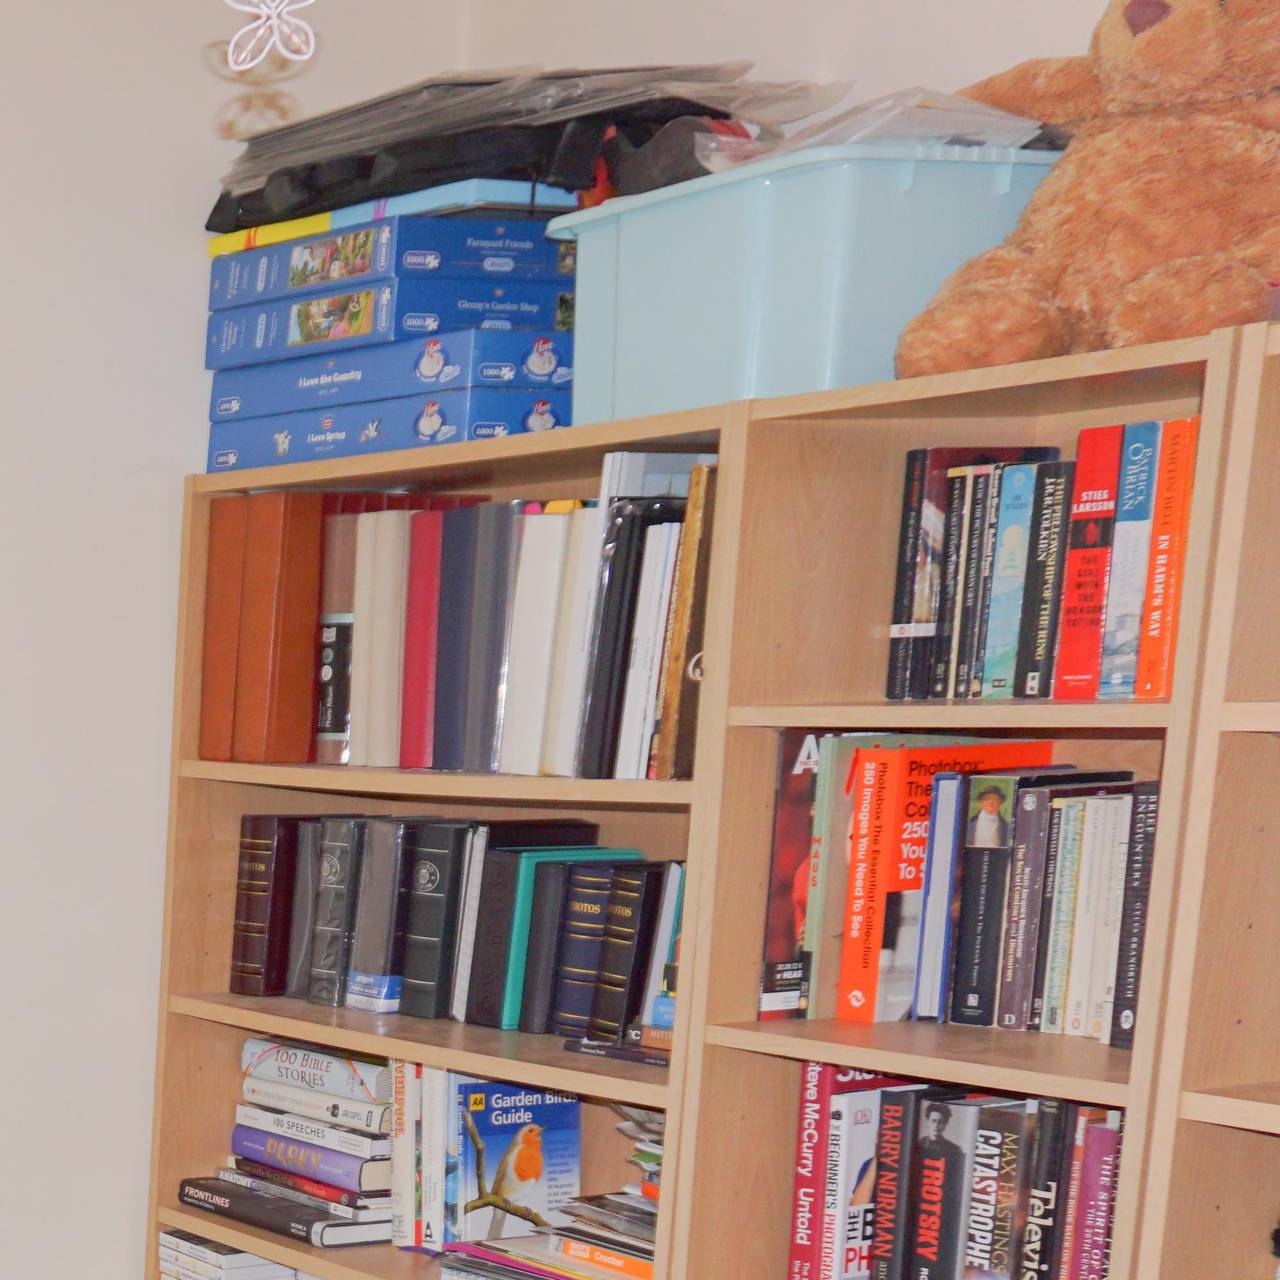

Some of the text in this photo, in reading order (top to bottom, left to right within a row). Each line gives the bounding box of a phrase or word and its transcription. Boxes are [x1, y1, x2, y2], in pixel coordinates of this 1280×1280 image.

[1134, 447, 1153, 505] PATRICK
[1072, 500, 1115, 514] LARSSON
[1080, 489, 1109, 501] STIEG
[1037, 507, 1053, 561] TOLKIEN
[1157, 534, 1170, 550] IN
[1035, 477, 1066, 660] THE FELLOWSHIP OF THE RING
[1151, 554, 1169, 606] HARM'S
[1148, 609, 1162, 639] WAY
[1145, 795, 1157, 834] BRIEF
[850, 762, 876, 939] 250 Images You Need To See
[1131, 795, 1147, 888] ENCOUNTERS
[809, 835, 823, 888] MAUS
[862, 761, 888, 969] Photobox The Essential Collection
[898, 863, 916, 879] To
[1006, 843, 1027, 982] The Social Contract and Discourses
[1124, 936, 1139, 998] BRANDRETH
[274, 1050, 333, 1073] 100 BIBLE
[277, 1066, 325, 1088] STORIES
[492, 1091, 541, 1108] Garden
[272, 1117, 326, 1138] 100 SPEECHES
[492, 1110, 532, 1125] Guide
[880, 1103, 903, 1166] BARRY
[795, 1102, 820, 1245] McCurry Untold
[826, 1133, 841, 1210] BEGINNER'S
[1070, 1160, 1081, 1179] PUT
[1100, 1154, 1114, 1186] THE
[184, 1186, 230, 1208] FRONTLINES
[965, 1129, 1002, 1271] CATASTROPHE
[991, 1131, 1020, 1274] MAX HASTINGS
[1068, 1180, 1079, 1198] THE
[874, 1170, 898, 1258] NORMAN
[915, 1157, 946, 1262] TROTSKY
[1066, 1199, 1078, 1223] BOOK
[1086, 1208, 1096, 1225] THE
[1093, 1191, 1109, 1244] SPIRIT
[847, 1209, 861, 1244] THE
[1063, 1224, 1076, 1248] BACK
[1083, 1227, 1094, 1250] 20TH
[792, 1260, 801, 1273] the
[801, 1262, 811, 1276] The
[1061, 1248, 1073, 1262] ON
[1090, 1249, 1102, 1269] OF
[1059, 1264, 1069, 1280] THE
